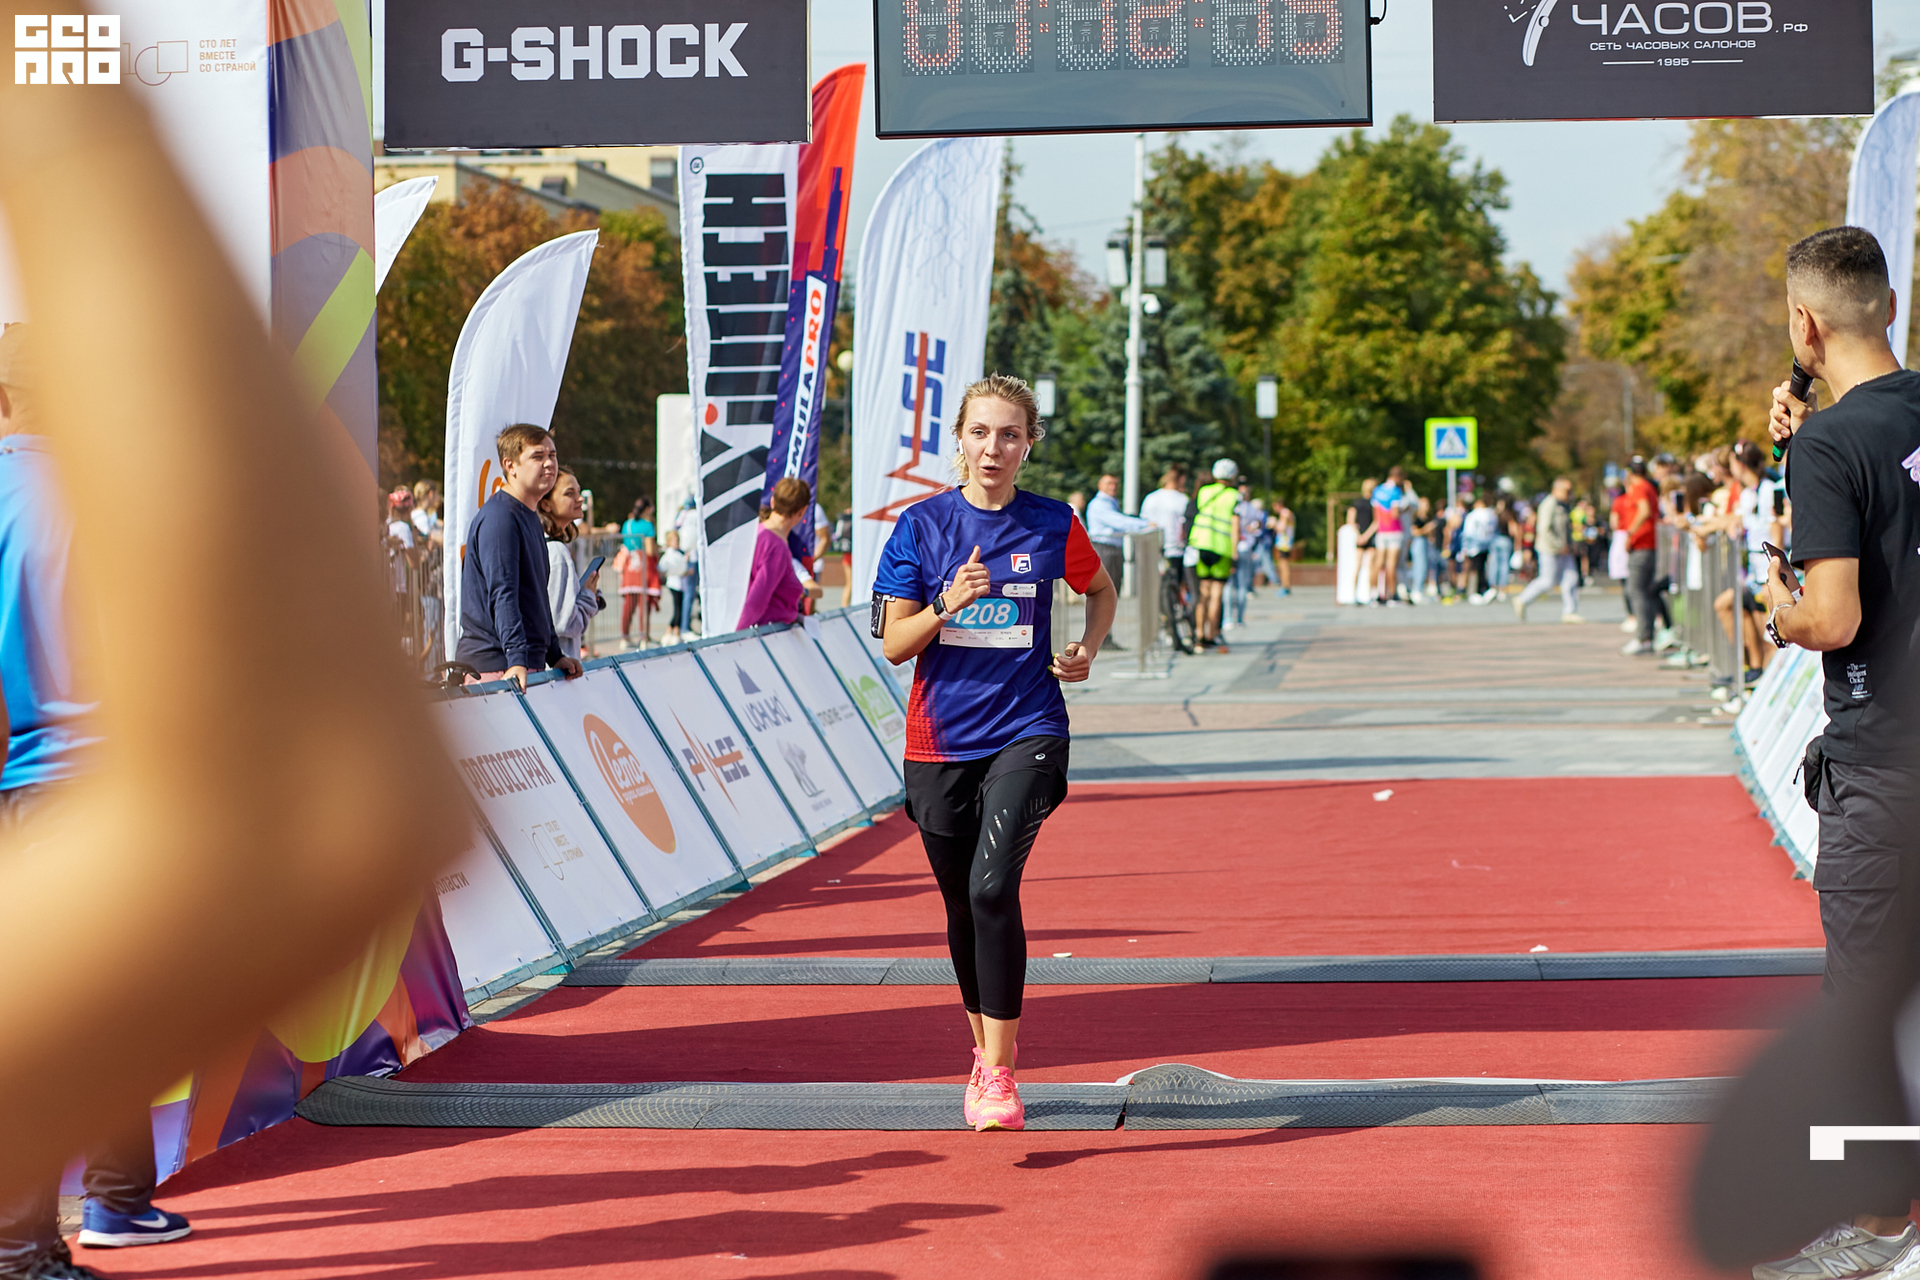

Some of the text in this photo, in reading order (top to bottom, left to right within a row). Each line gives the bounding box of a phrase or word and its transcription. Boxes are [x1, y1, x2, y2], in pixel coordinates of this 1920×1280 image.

[199, 38, 237, 49] СТО ЛЕТ
[1589, 39, 1757, 51] СЕТЬ ЧАСОВЫХ САЛОНОВ
[199, 51, 236, 61] ВМЕСТЕ
[441, 22, 749, 83] G-SHOCK
[199, 60, 256, 73] СО СТРАНОЙ
[1656, 57, 1690, 67] 1995
[955, 603, 1012, 625] 1208
[458, 745, 557, 800] РОСГОССТРАХ
